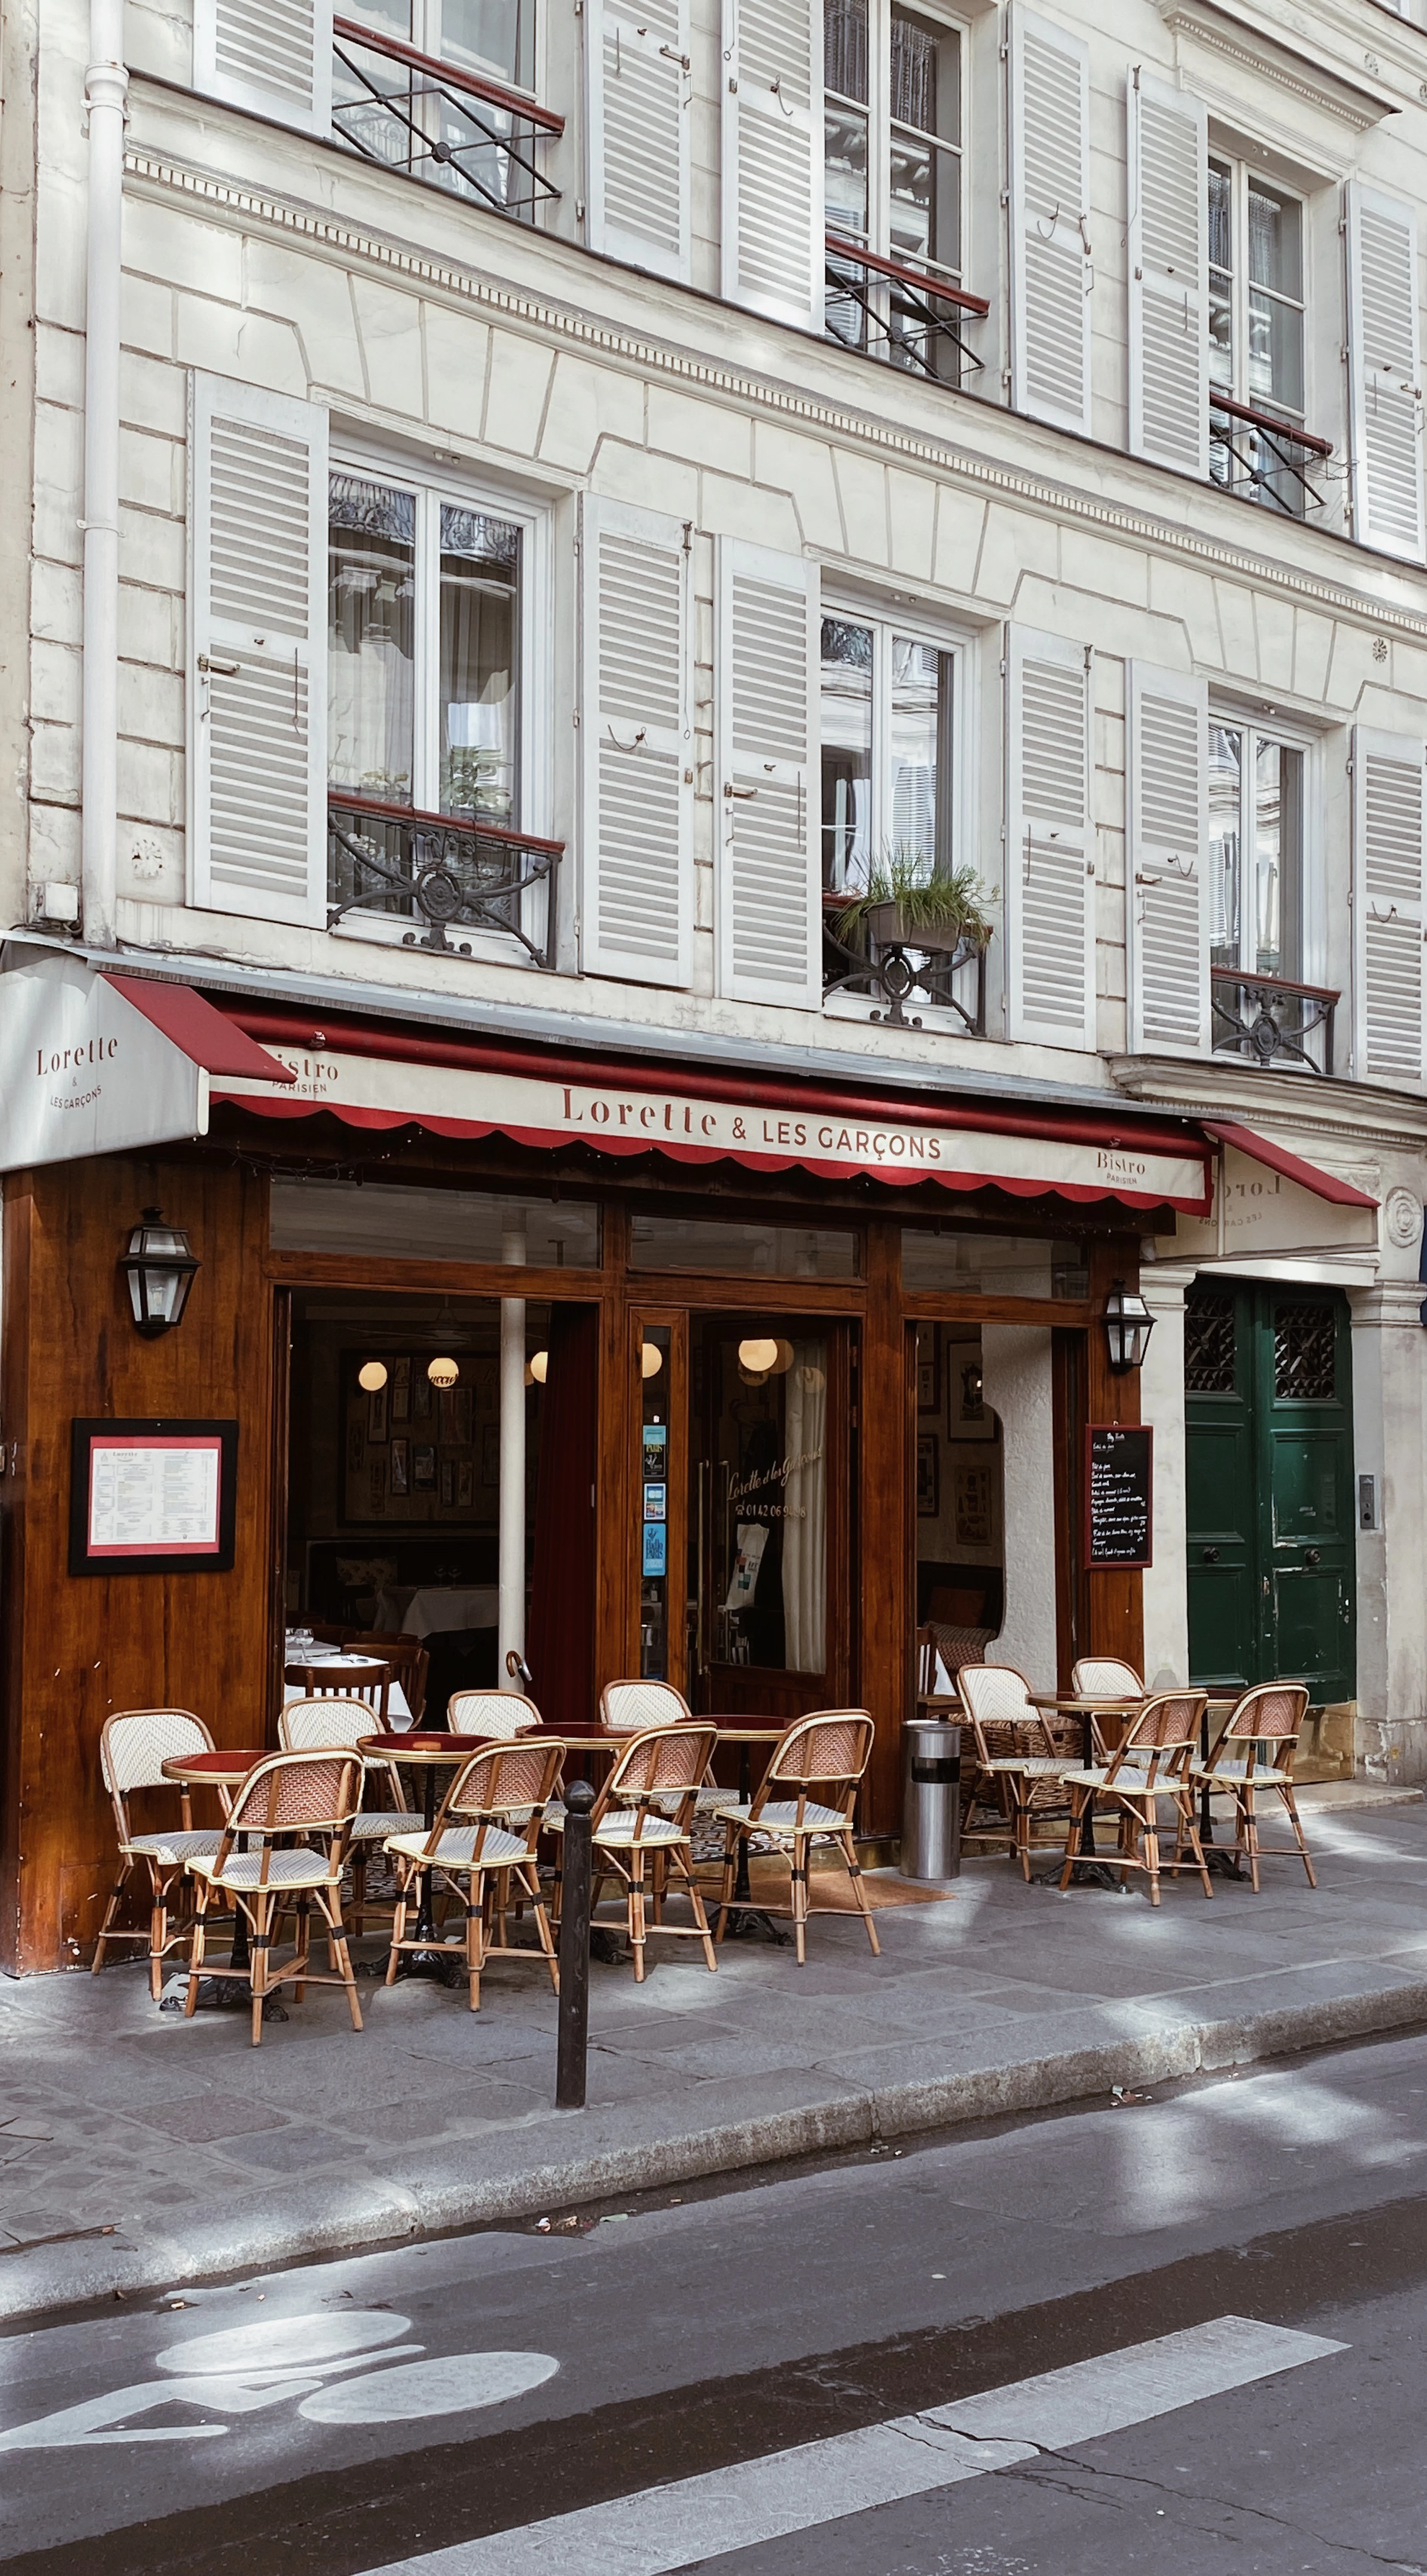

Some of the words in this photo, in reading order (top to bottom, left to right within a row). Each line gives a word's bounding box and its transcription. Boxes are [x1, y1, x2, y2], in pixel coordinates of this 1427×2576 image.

[37, 1037, 118, 1076] Lorette
[278, 1054, 338, 1080] stro
[72, 1077, 77, 1086] &
[272, 1081, 327, 1093] PARISIEN
[51, 1096, 62, 1108] LES
[64, 1085, 101, 1109] GARÇONS
[562, 1088, 716, 1136] Lorette
[732, 1117, 747, 1140] &
[763, 1120, 806, 1146] LES
[818, 1127, 941, 1160] GARÇONS
[1097, 1152, 1145, 1174] Bistro
[1107, 1172, 1137, 1185] PARISIEN
[727, 1469, 762, 1501] Lorette
